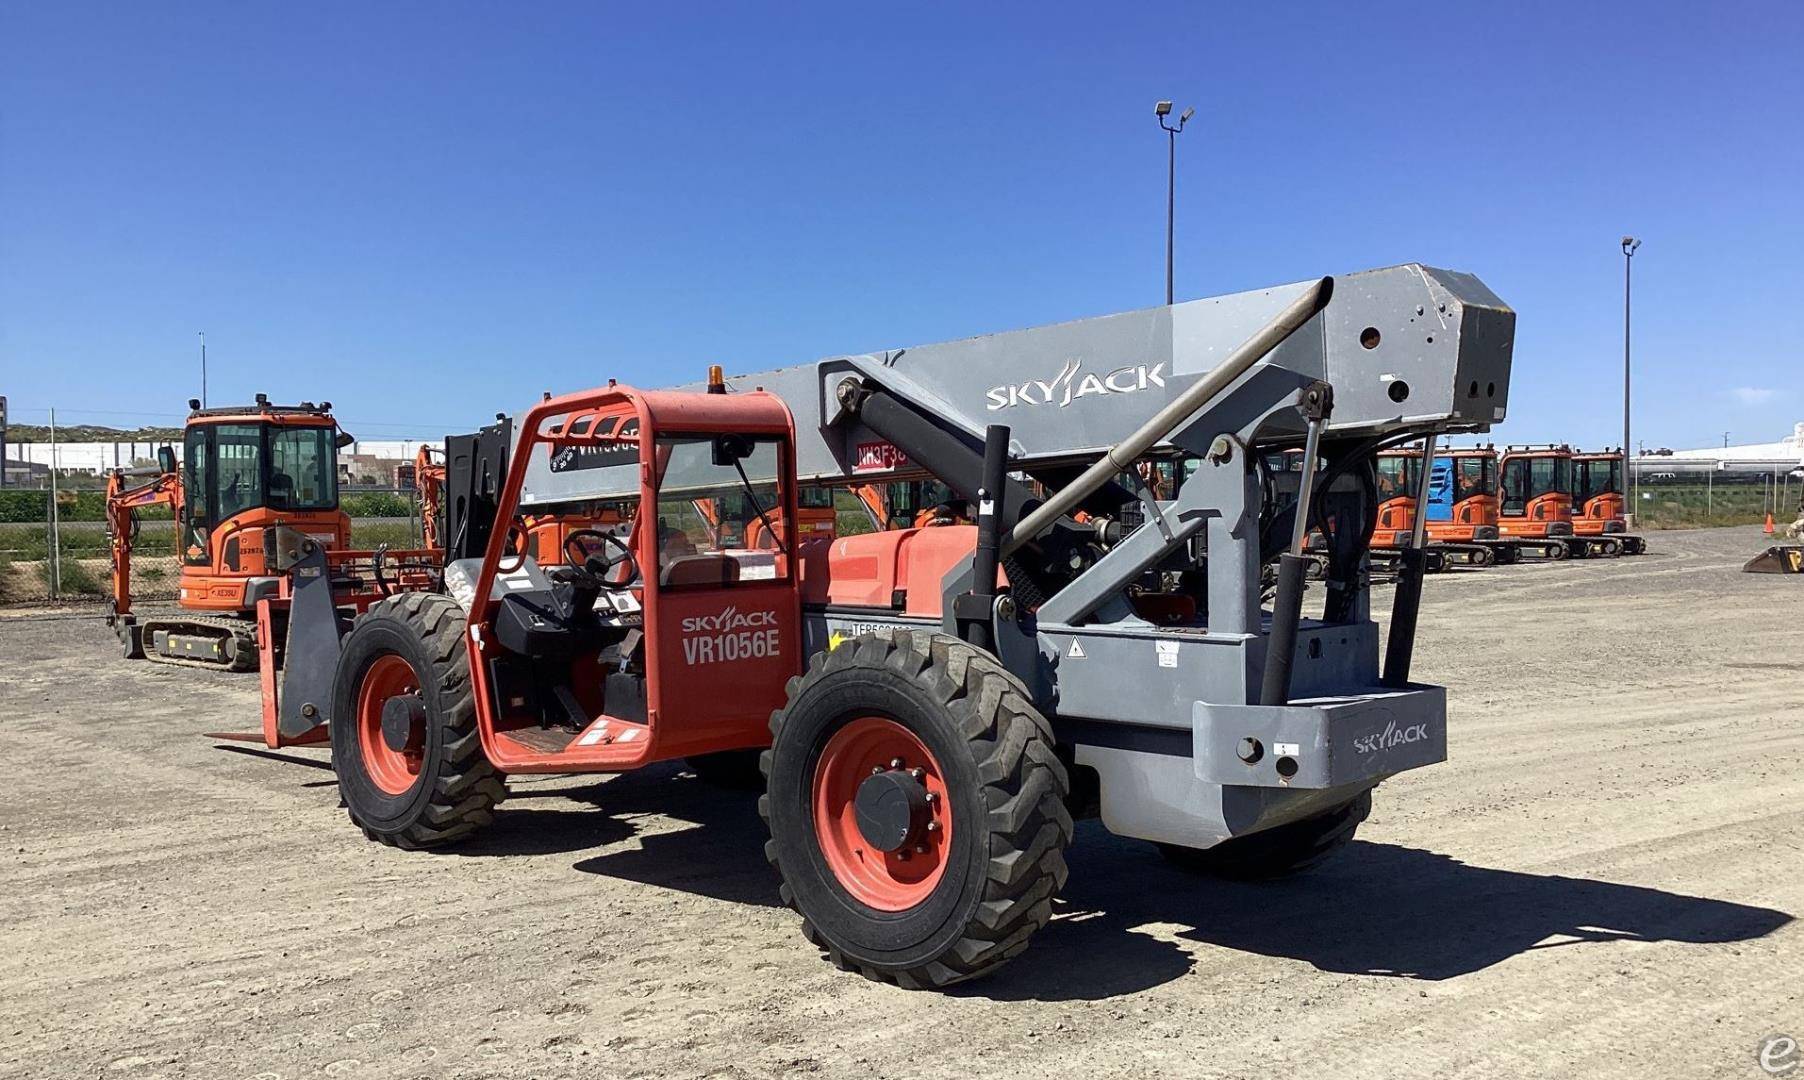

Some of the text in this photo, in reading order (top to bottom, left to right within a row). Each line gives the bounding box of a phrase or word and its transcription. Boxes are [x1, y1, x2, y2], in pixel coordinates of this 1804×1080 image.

[986, 357, 1167, 410] SKYJACK
[682, 605, 777, 632] SKYJACK
[683, 629, 780, 665] VR1056E
[1353, 719, 1428, 754] SKYJACK
